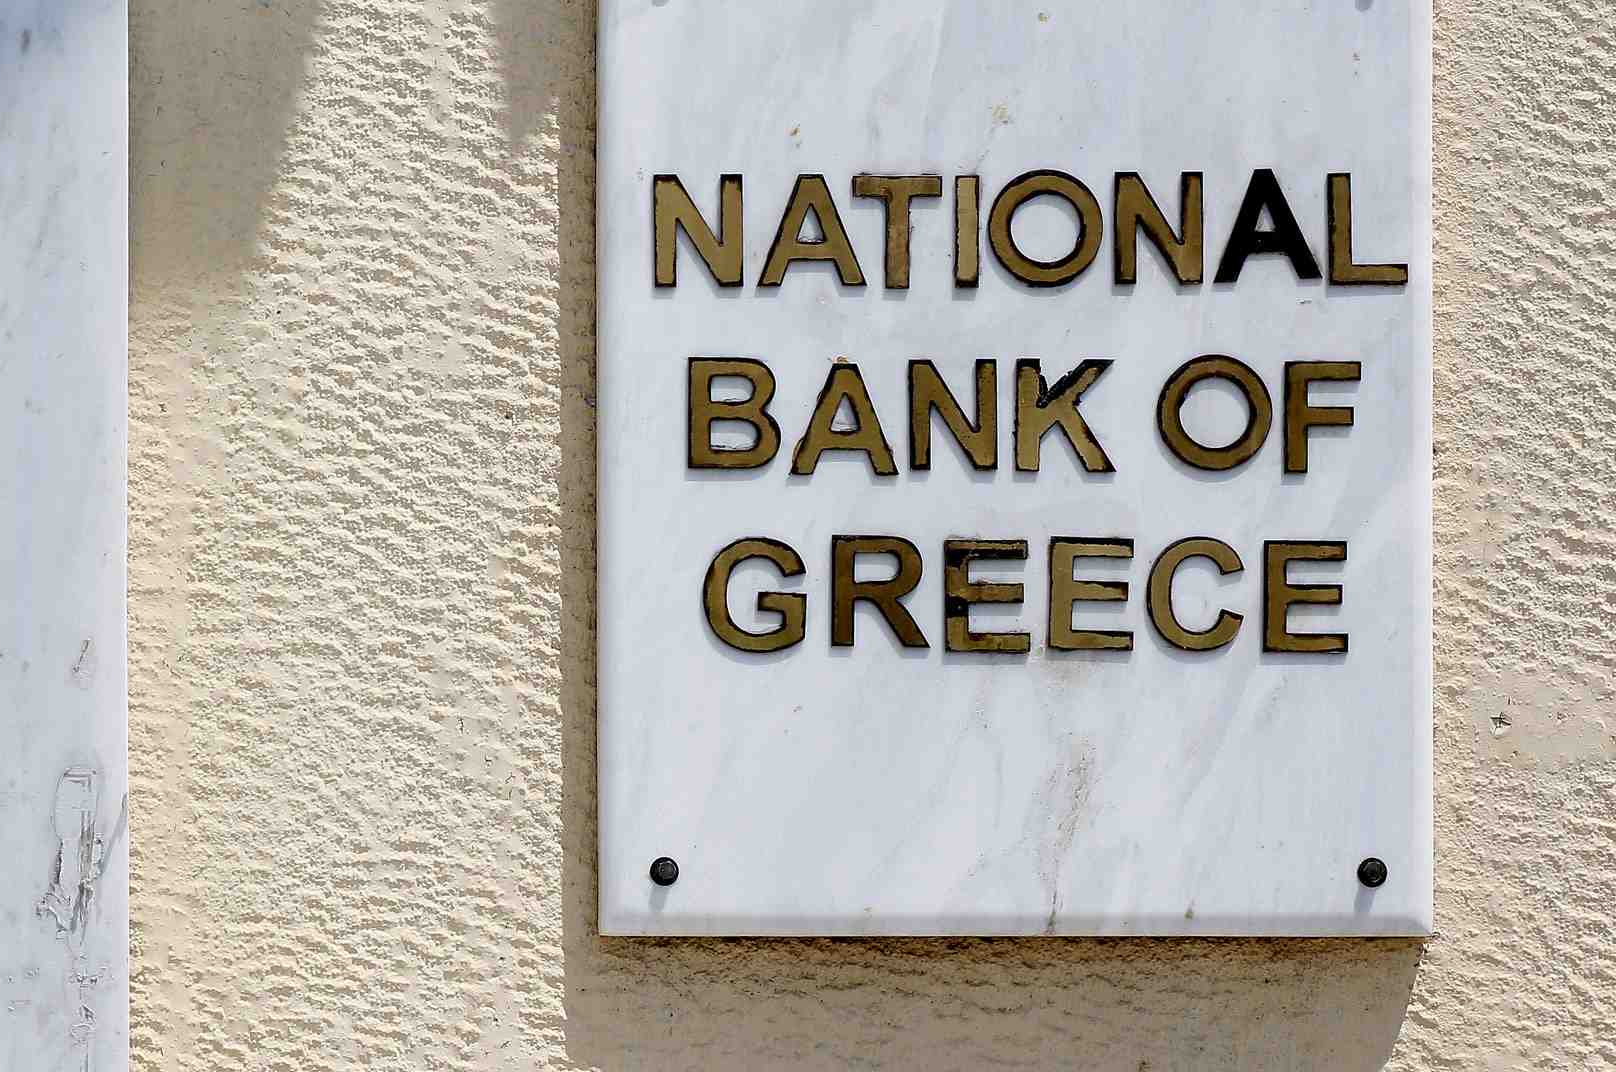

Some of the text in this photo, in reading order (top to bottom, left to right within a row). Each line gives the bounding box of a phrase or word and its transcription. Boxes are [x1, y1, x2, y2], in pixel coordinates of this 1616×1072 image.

[653, 167, 1409, 289] NATIONAL
[686, 354, 1363, 476] BANK OF
[702, 535, 1350, 655] GREECE
